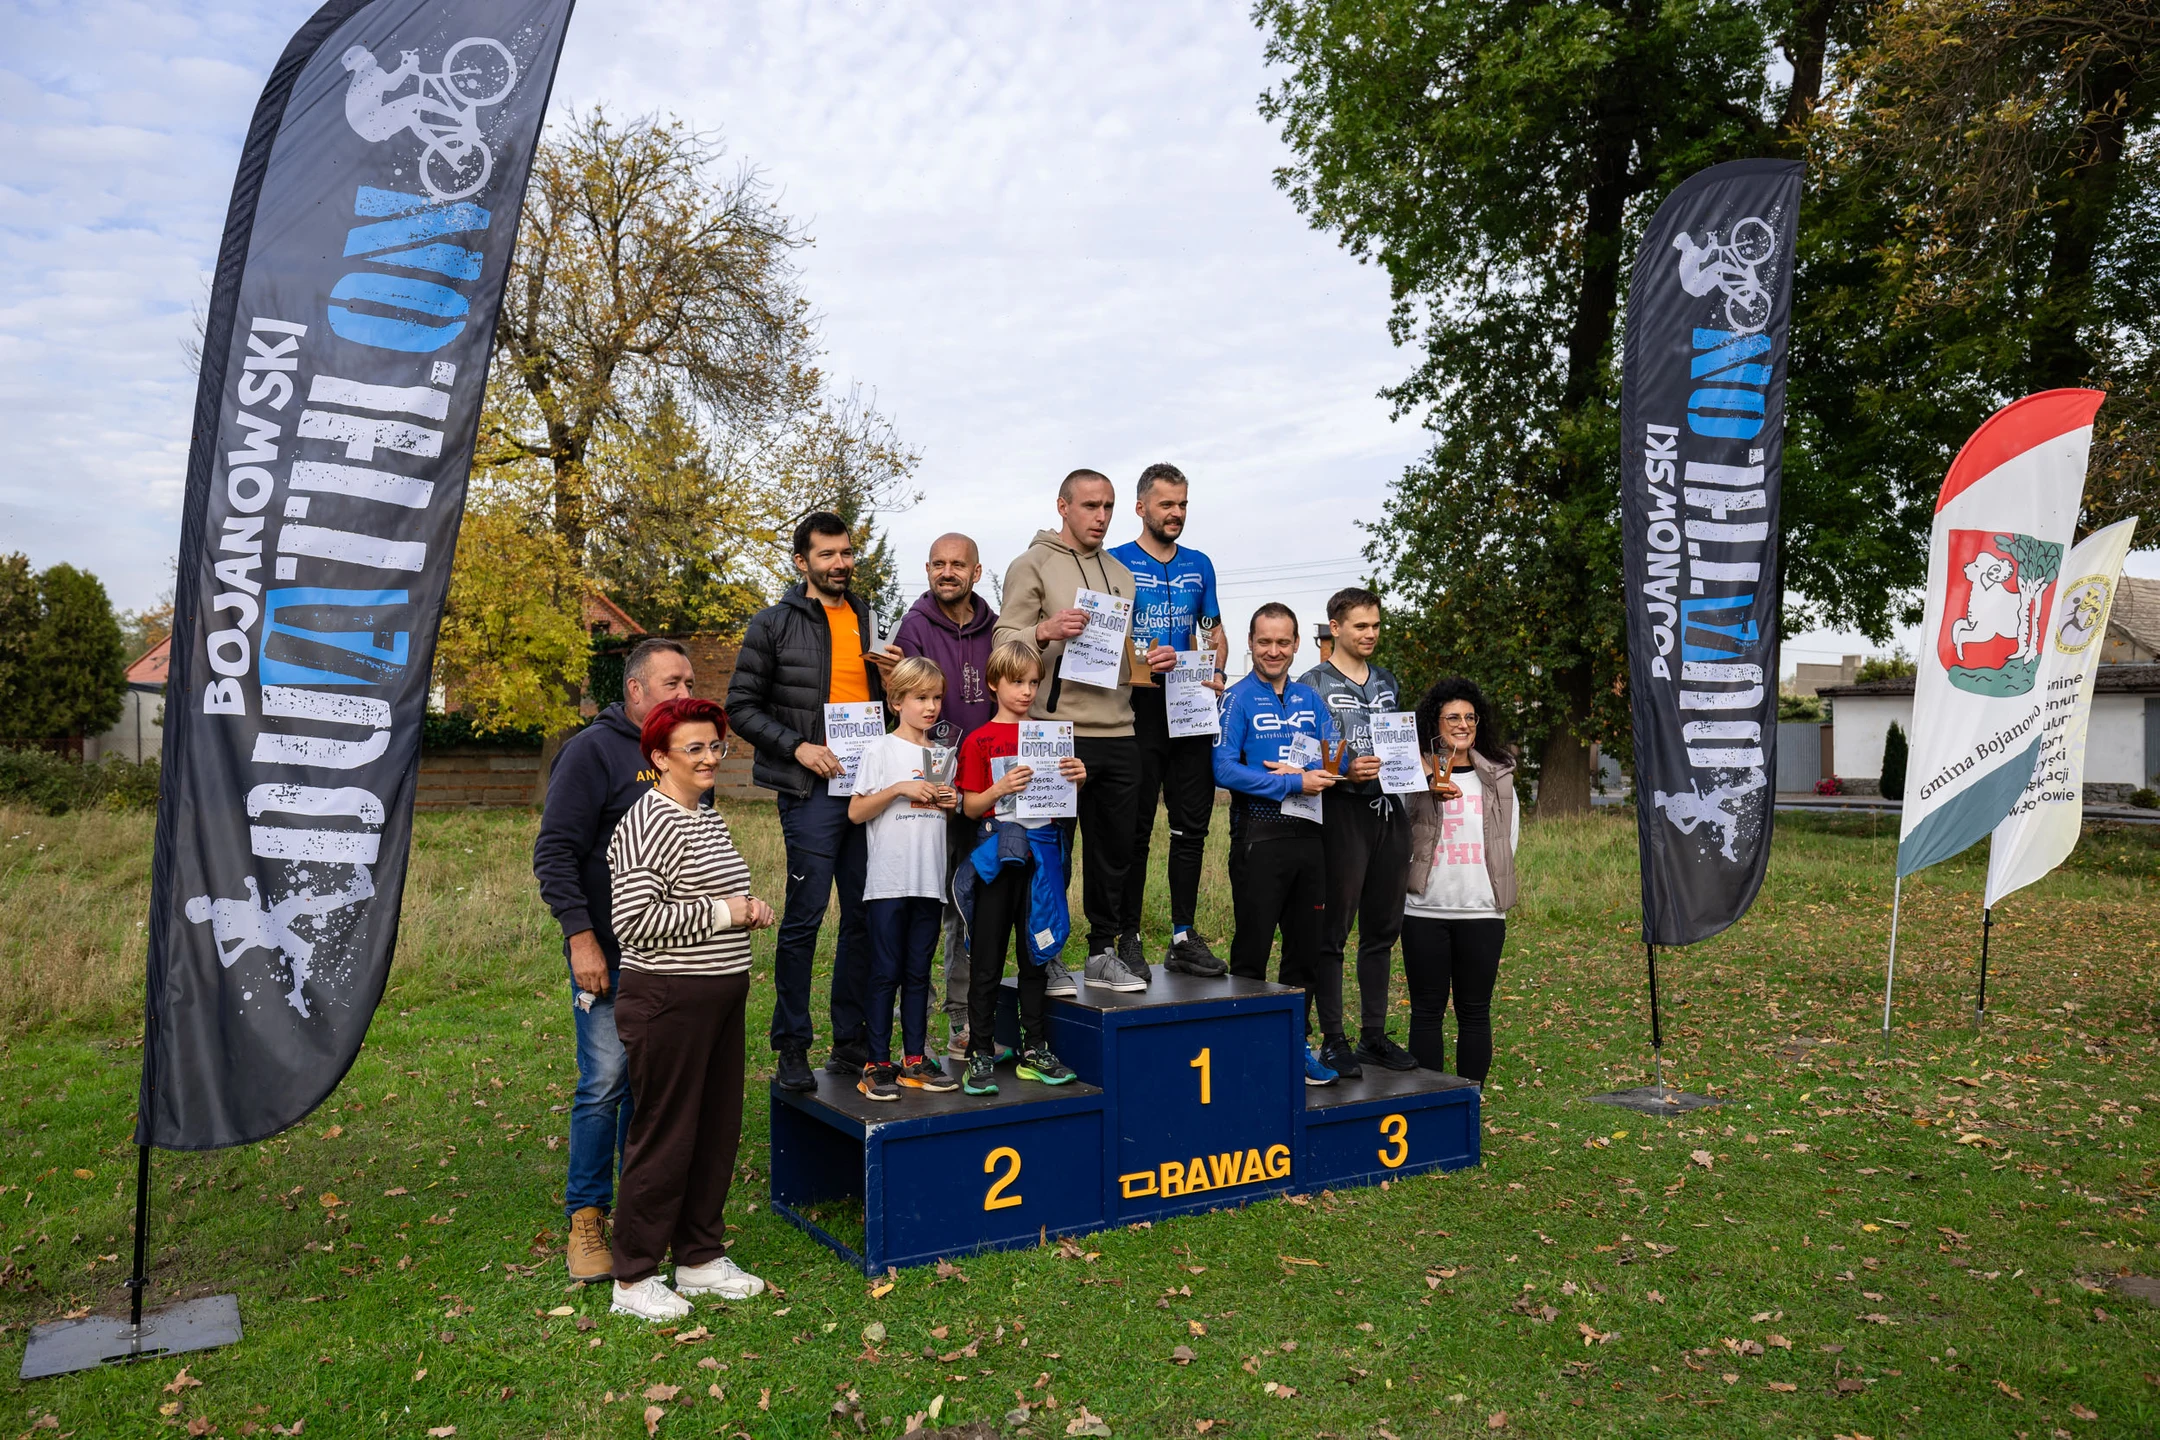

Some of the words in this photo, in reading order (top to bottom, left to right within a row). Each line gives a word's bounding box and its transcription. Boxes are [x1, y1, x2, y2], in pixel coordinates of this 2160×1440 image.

[203, 316, 308, 716] BOJANOWSKI
[1085, 610, 1127, 633] YPLOM
[1168, 667, 1213, 684] DYPLOM
[828, 720, 884, 739] DYPLOM
[1374, 729, 1417, 745] DYPLOM
[1021, 740, 1073, 758] DYPLOM
[1920, 756, 1976, 800] Gmina
[1432, 842, 1482, 867] THI
[1190, 1047, 1211, 1105] 1
[1377, 1113, 1409, 1169] 3
[983, 1146, 1023, 1212] 2
